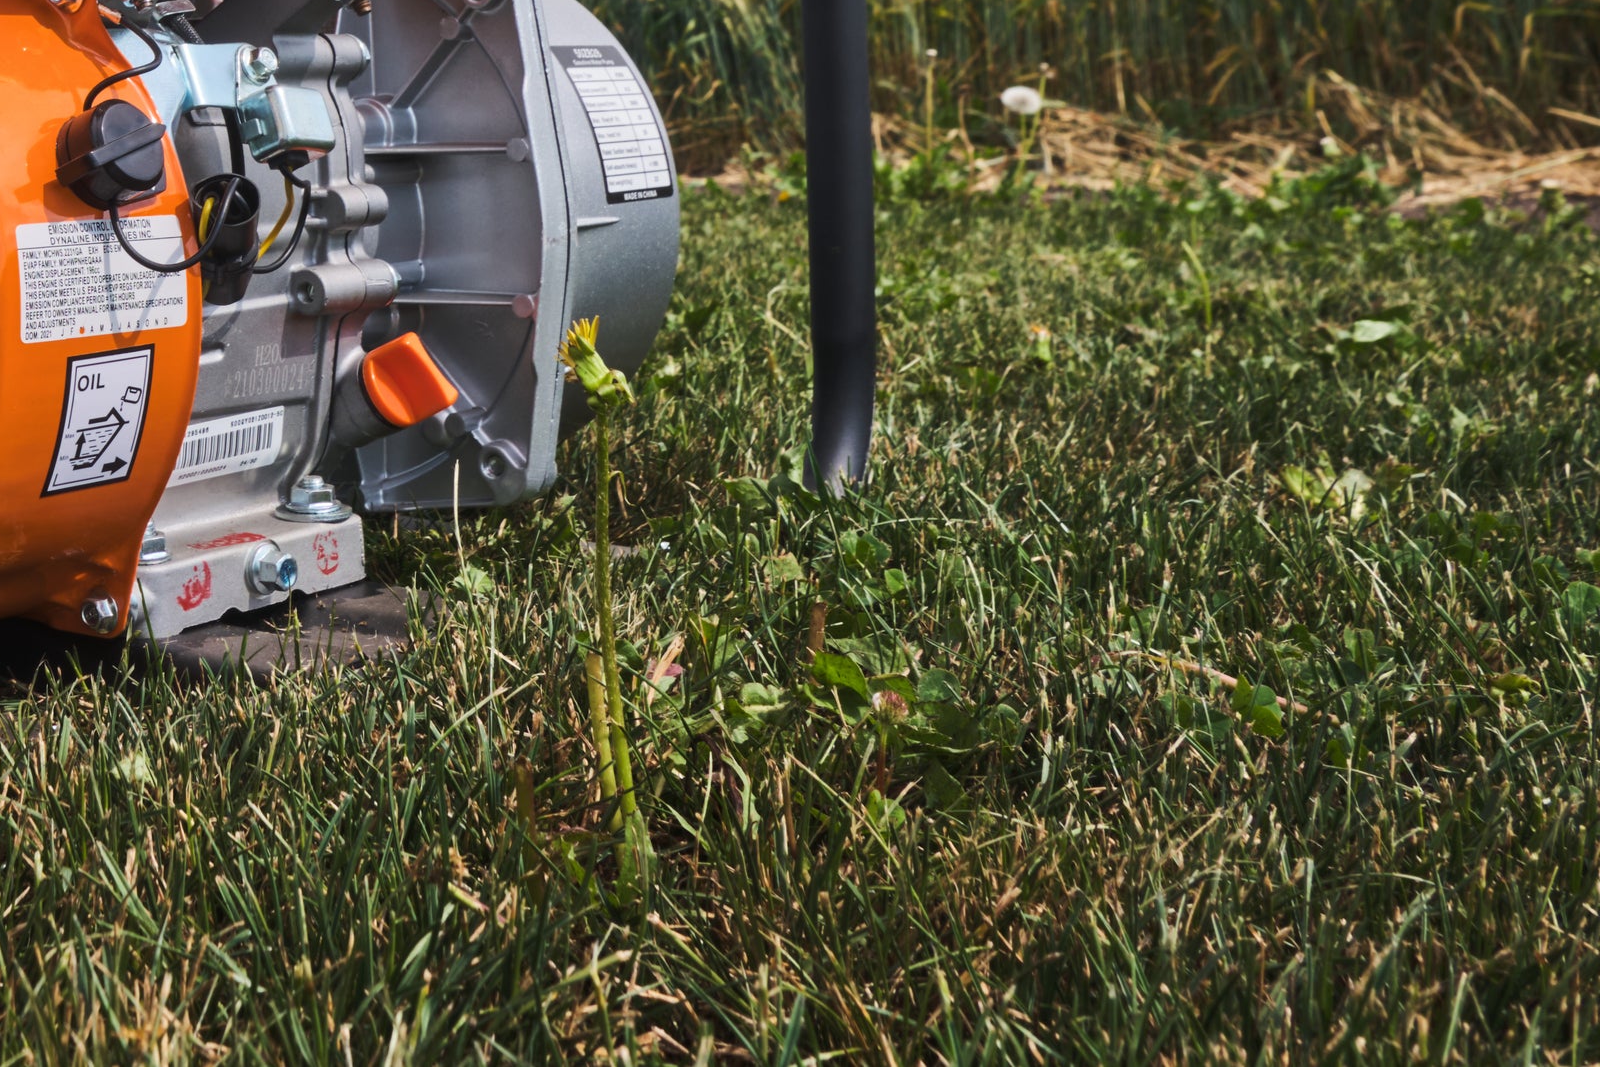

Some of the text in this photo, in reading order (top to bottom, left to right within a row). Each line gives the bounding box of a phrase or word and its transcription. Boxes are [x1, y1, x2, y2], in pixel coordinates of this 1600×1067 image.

[624, 190, 658, 201] MADE IN CHINA
[48, 223, 78, 234] EMISSION
[78, 221, 109, 232] CONTROL
[49, 234, 90, 245] DYNALINE
[23, 260, 37, 270] EVAP
[24, 270, 44, 280] ENGINE
[86, 265, 100, 274] 196cc
[24, 280, 37, 290] THIS
[37, 279, 57, 289] ENGINE
[58, 278, 63, 287] IS
[64, 276, 90, 286] CERTIFIED
[91, 275, 98, 284] TO
[98, 273, 121, 283] OPERATE
[122, 272, 129, 281] ON
[129, 270, 155, 280] UNLEADED
[25, 291, 37, 300] THIS
[38, 289, 57, 299] ENGINE
[59, 287, 76, 297] MEETS
[87, 285, 97, 294] EPA
[119, 282, 132, 291] REGS
[133, 281, 143, 289] FOR
[25, 299, 51, 310] EMISSION
[51, 296, 85, 307] COMPLIANCE
[86, 294, 104, 304] PERIOD
[109, 293, 117, 302] 125
[118, 291, 135, 301] HOURS
[25, 310, 43, 320] REFER
[44, 309, 51, 318] TO
[77, 305, 98, 315] MANUAL
[99, 304, 109, 312] FOR
[109, 300, 144, 311] MAINTENANCE
[145, 296, 183, 307] SPECIFICATIONS
[25, 317, 75, 330] AND ADJUSTMENTS
[39, 329, 51, 338] 2021
[60, 328, 64, 336] J
[70, 326, 74, 335] F
[77, 373, 105, 391] OIL
